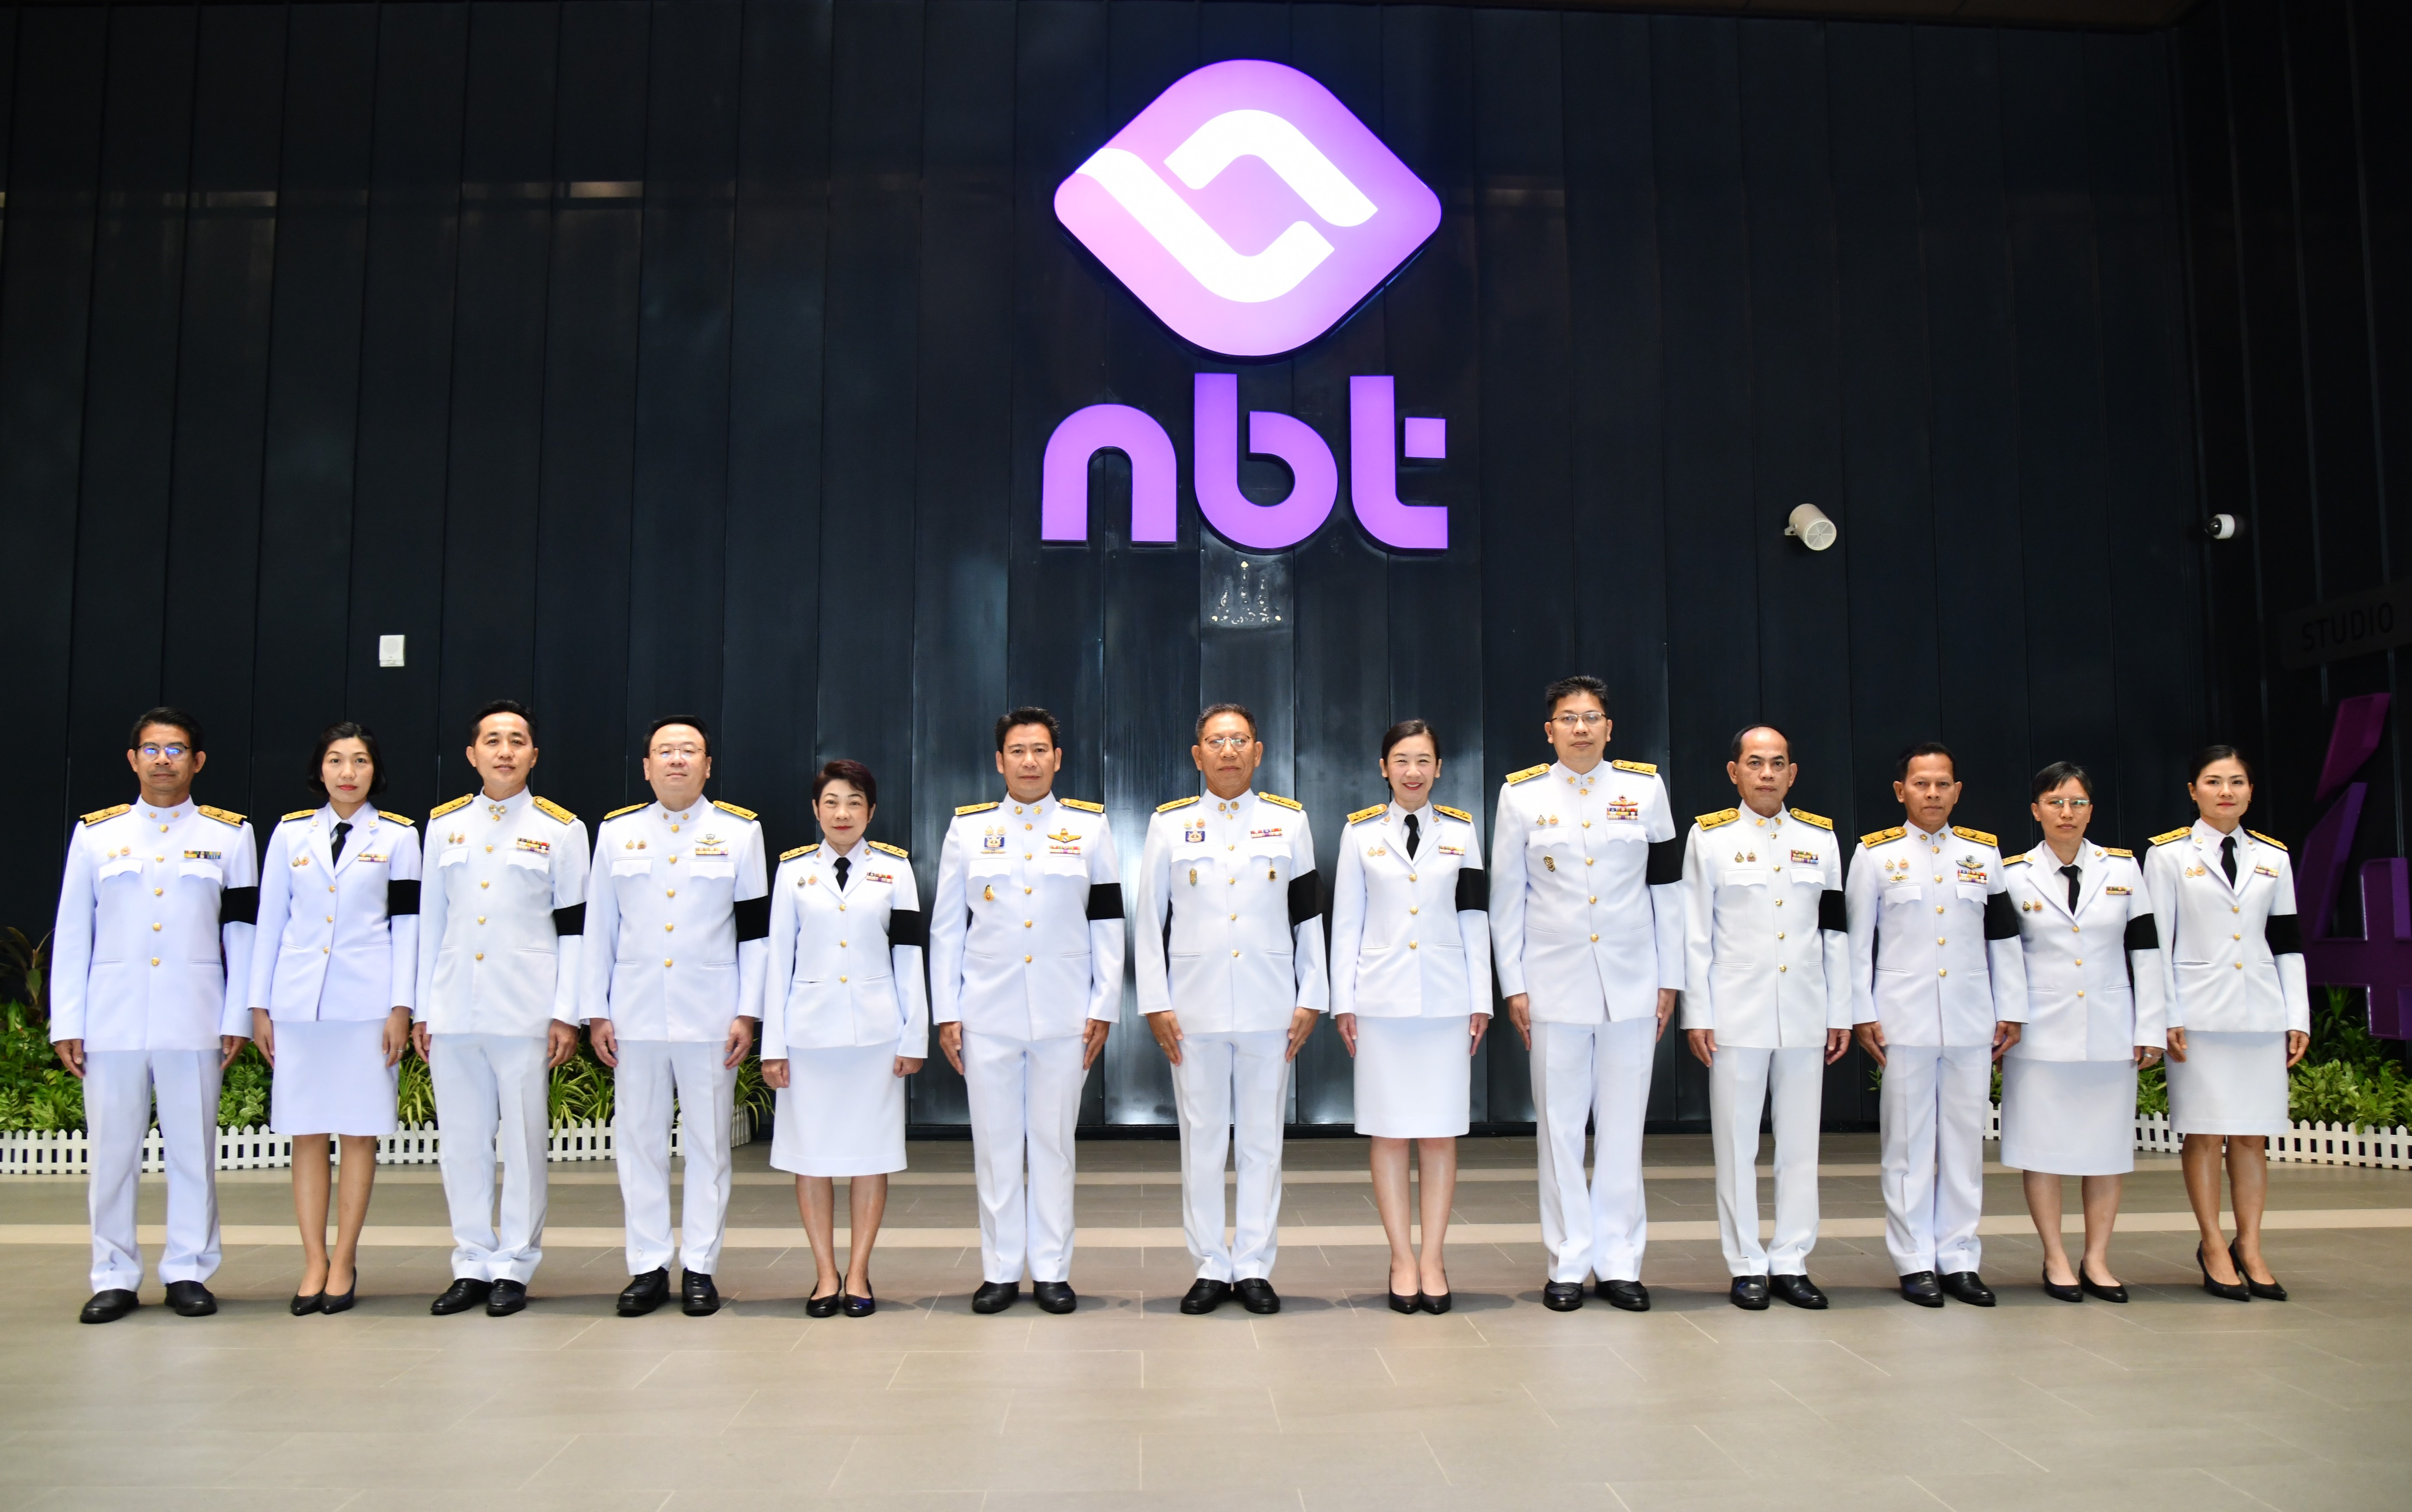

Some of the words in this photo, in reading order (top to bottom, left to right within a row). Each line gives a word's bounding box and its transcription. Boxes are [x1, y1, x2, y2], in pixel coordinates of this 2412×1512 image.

[1041, 373, 1448, 550] nbt
[2302, 602, 2393, 652] STUDIO
[2295, 693, 2412, 1041] 4
